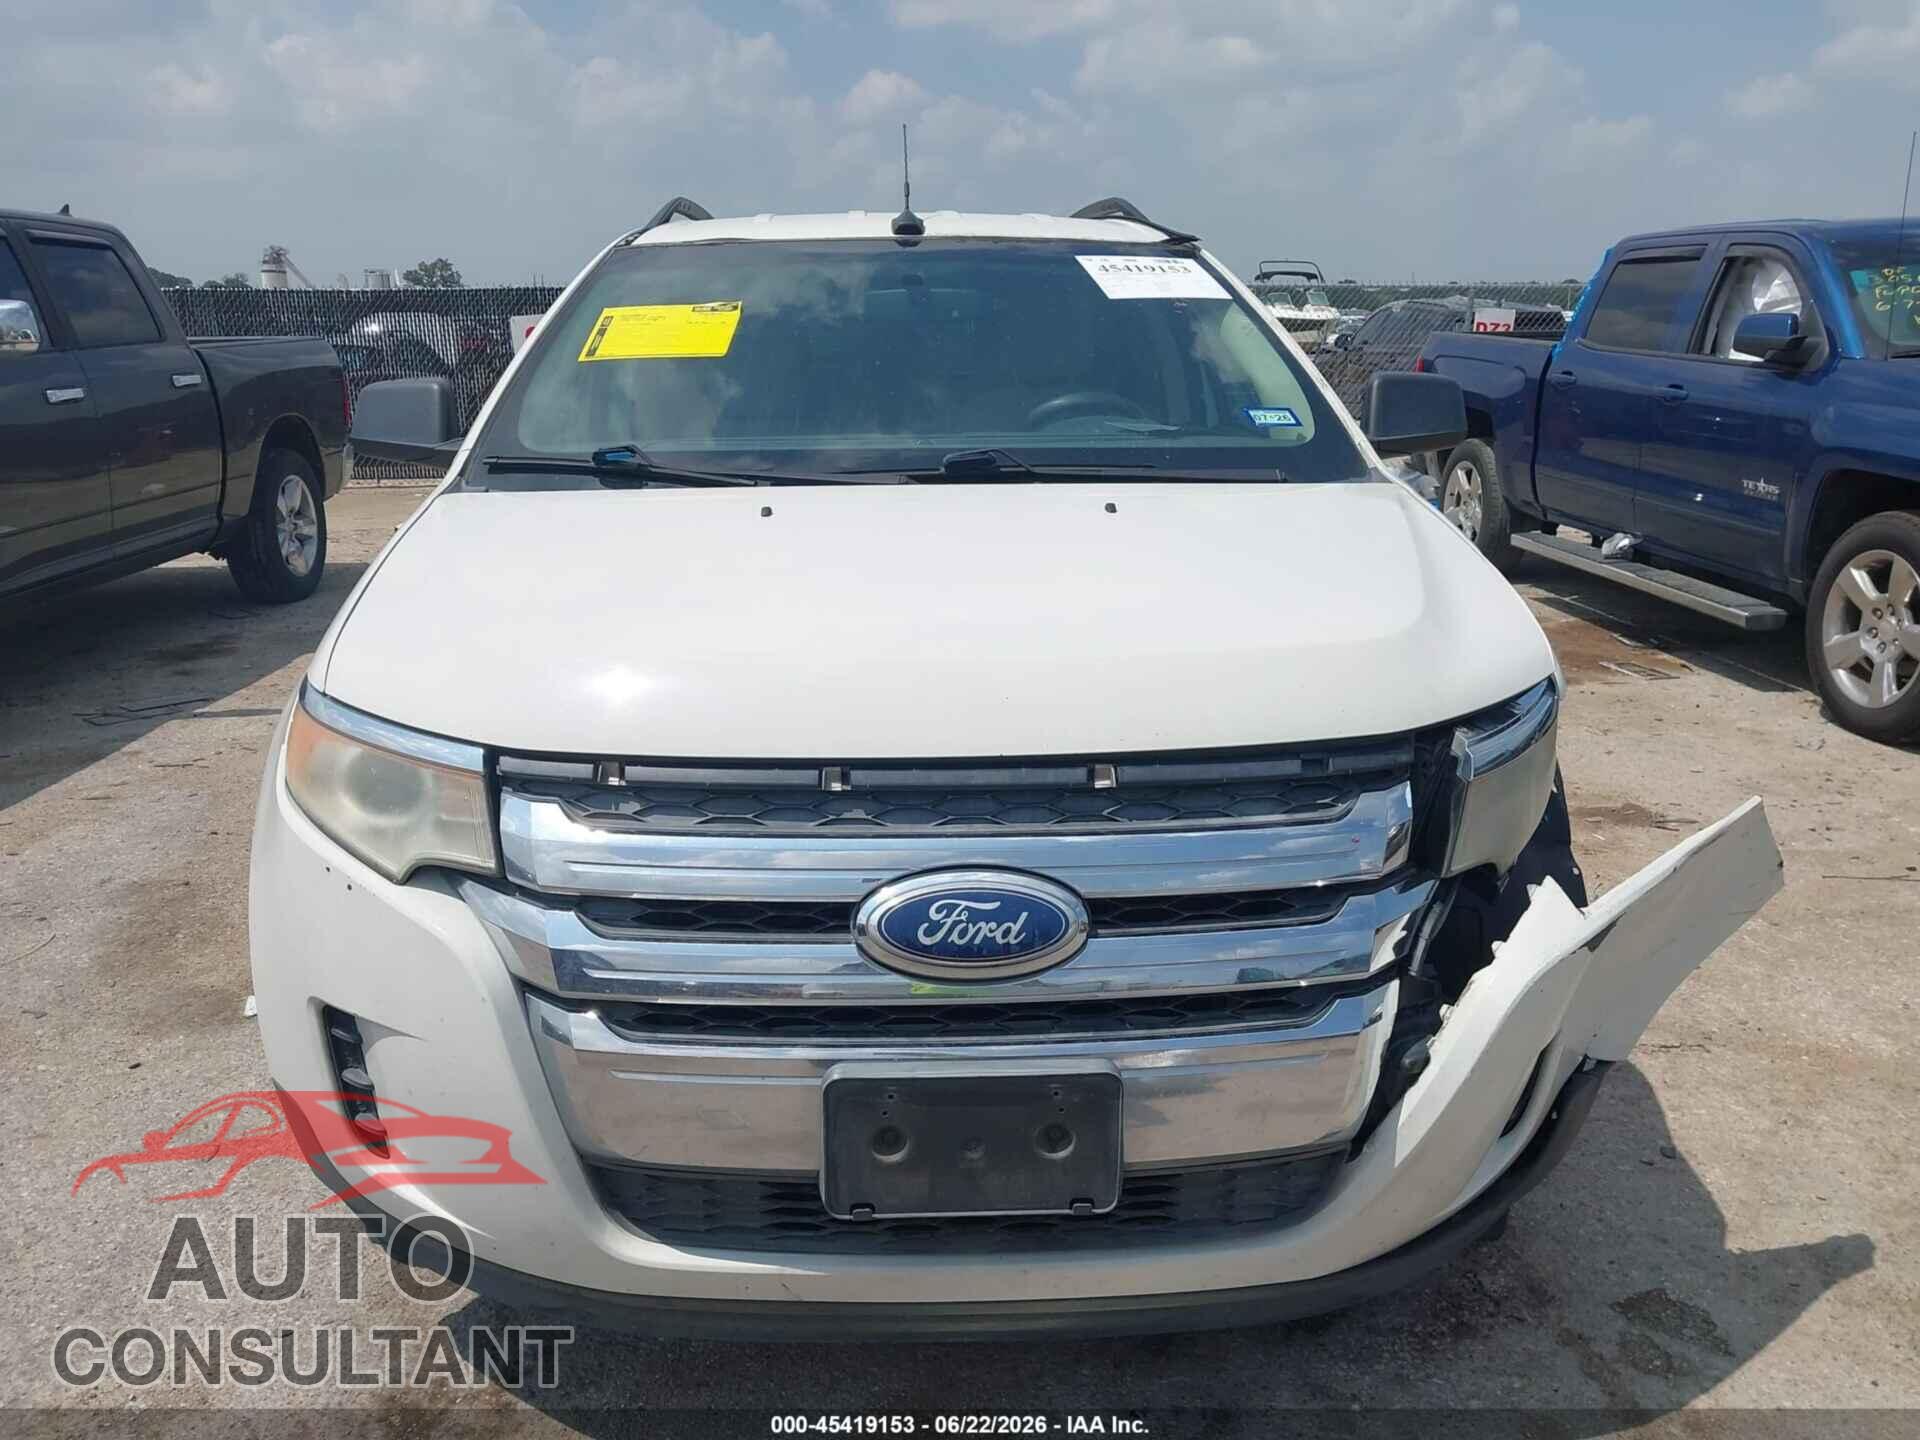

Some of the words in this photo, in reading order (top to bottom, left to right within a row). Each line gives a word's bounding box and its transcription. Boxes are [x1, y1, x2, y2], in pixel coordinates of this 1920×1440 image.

[1097, 263, 1193, 274] 45419153
[1741, 478, 1780, 495] TEXAS
[917, 899, 1029, 946] Ford
